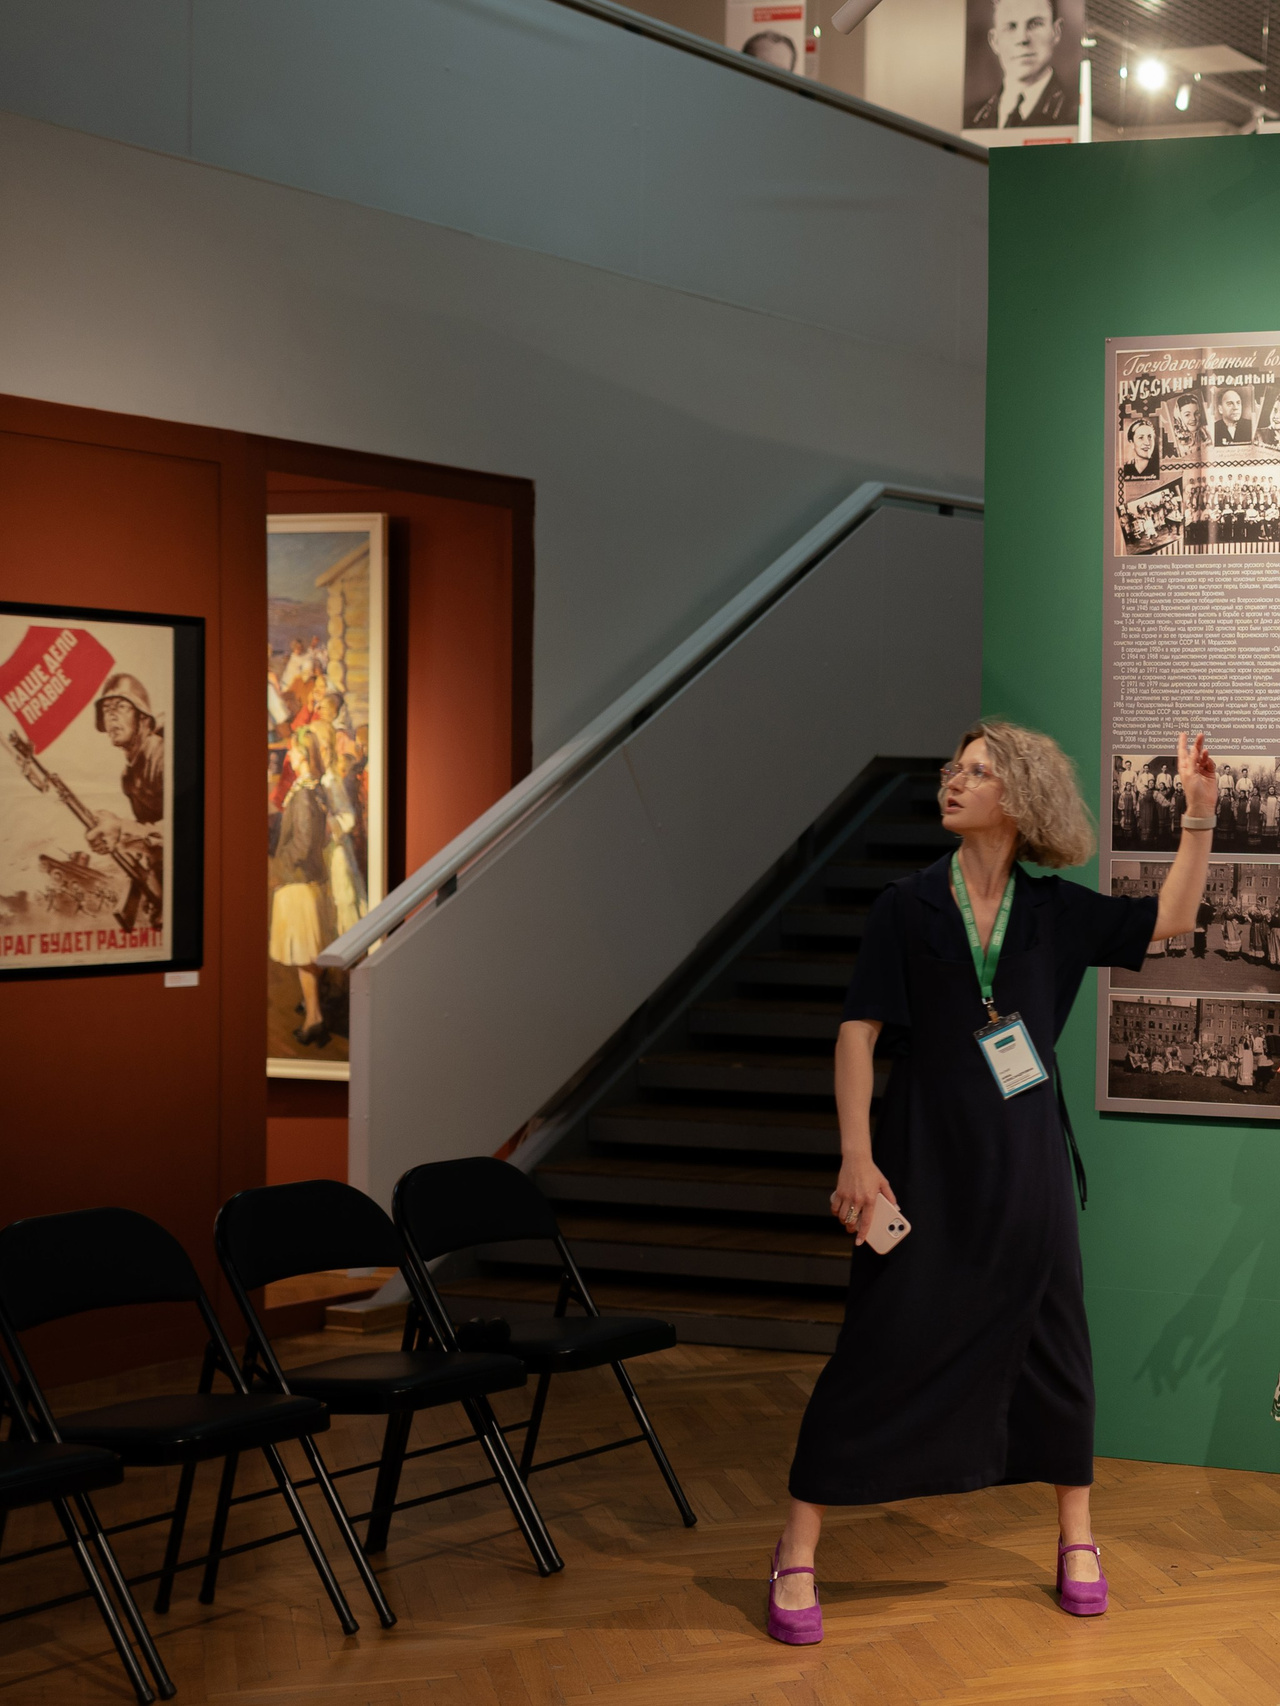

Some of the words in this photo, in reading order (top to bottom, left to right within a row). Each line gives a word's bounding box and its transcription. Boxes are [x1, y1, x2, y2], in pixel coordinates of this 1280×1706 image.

[1123, 351, 1258, 376] Государственный
[1118, 373, 1193, 403] РУССКИЙ
[3, 663, 50, 714] НАШЕ
[42, 629, 78, 675] ДЕЛО
[20, 668, 72, 725] ПРАВОЕ
[0, 934, 36, 957] РАГ
[40, 930, 93, 955] БУДЕТ
[97, 927, 163, 951] РАЗБИТ!
